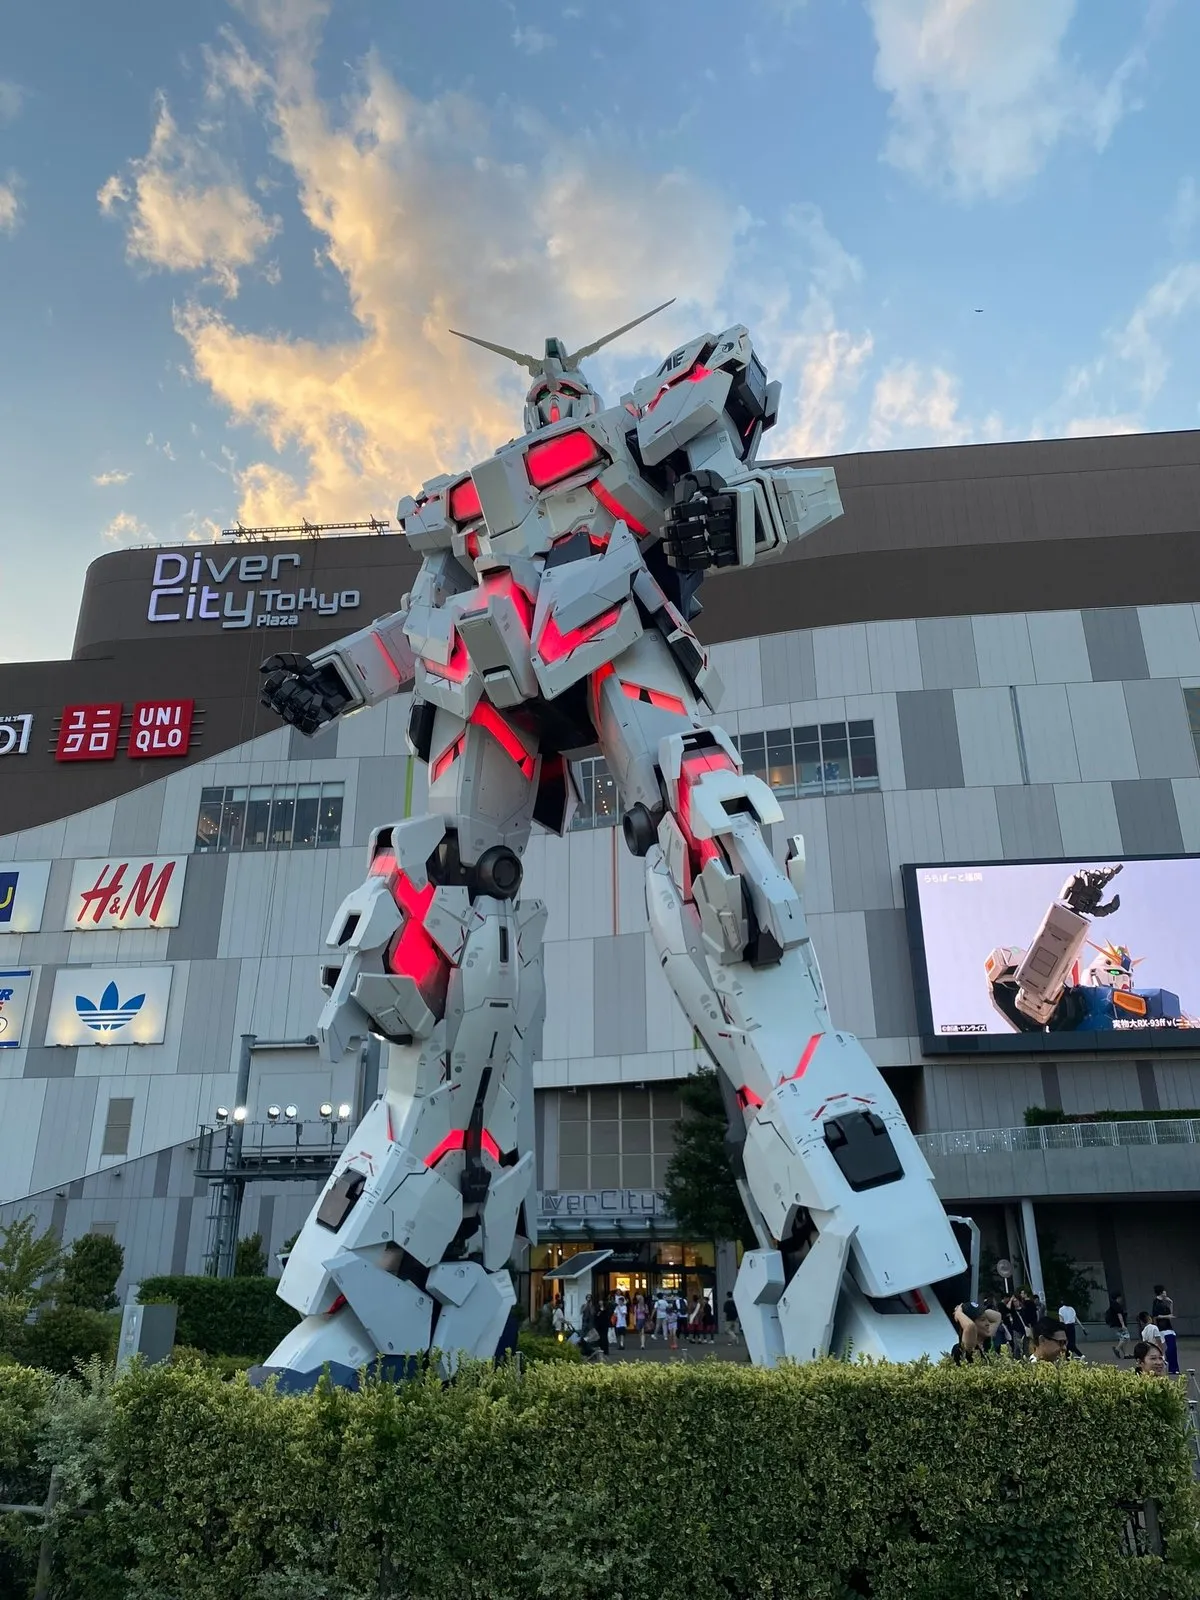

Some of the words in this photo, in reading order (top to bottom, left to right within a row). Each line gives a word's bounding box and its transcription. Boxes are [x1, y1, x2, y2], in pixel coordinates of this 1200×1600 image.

[152, 551, 300, 586] Diver
[147, 585, 254, 629] City
[256, 613, 299, 627] Plaza
[69, 709, 111, 730] ユニ
[139, 706, 182, 726] UNI
[63, 732, 109, 752] クロ
[136, 728, 182, 752] QLO
[77, 861, 176, 924] H&M
